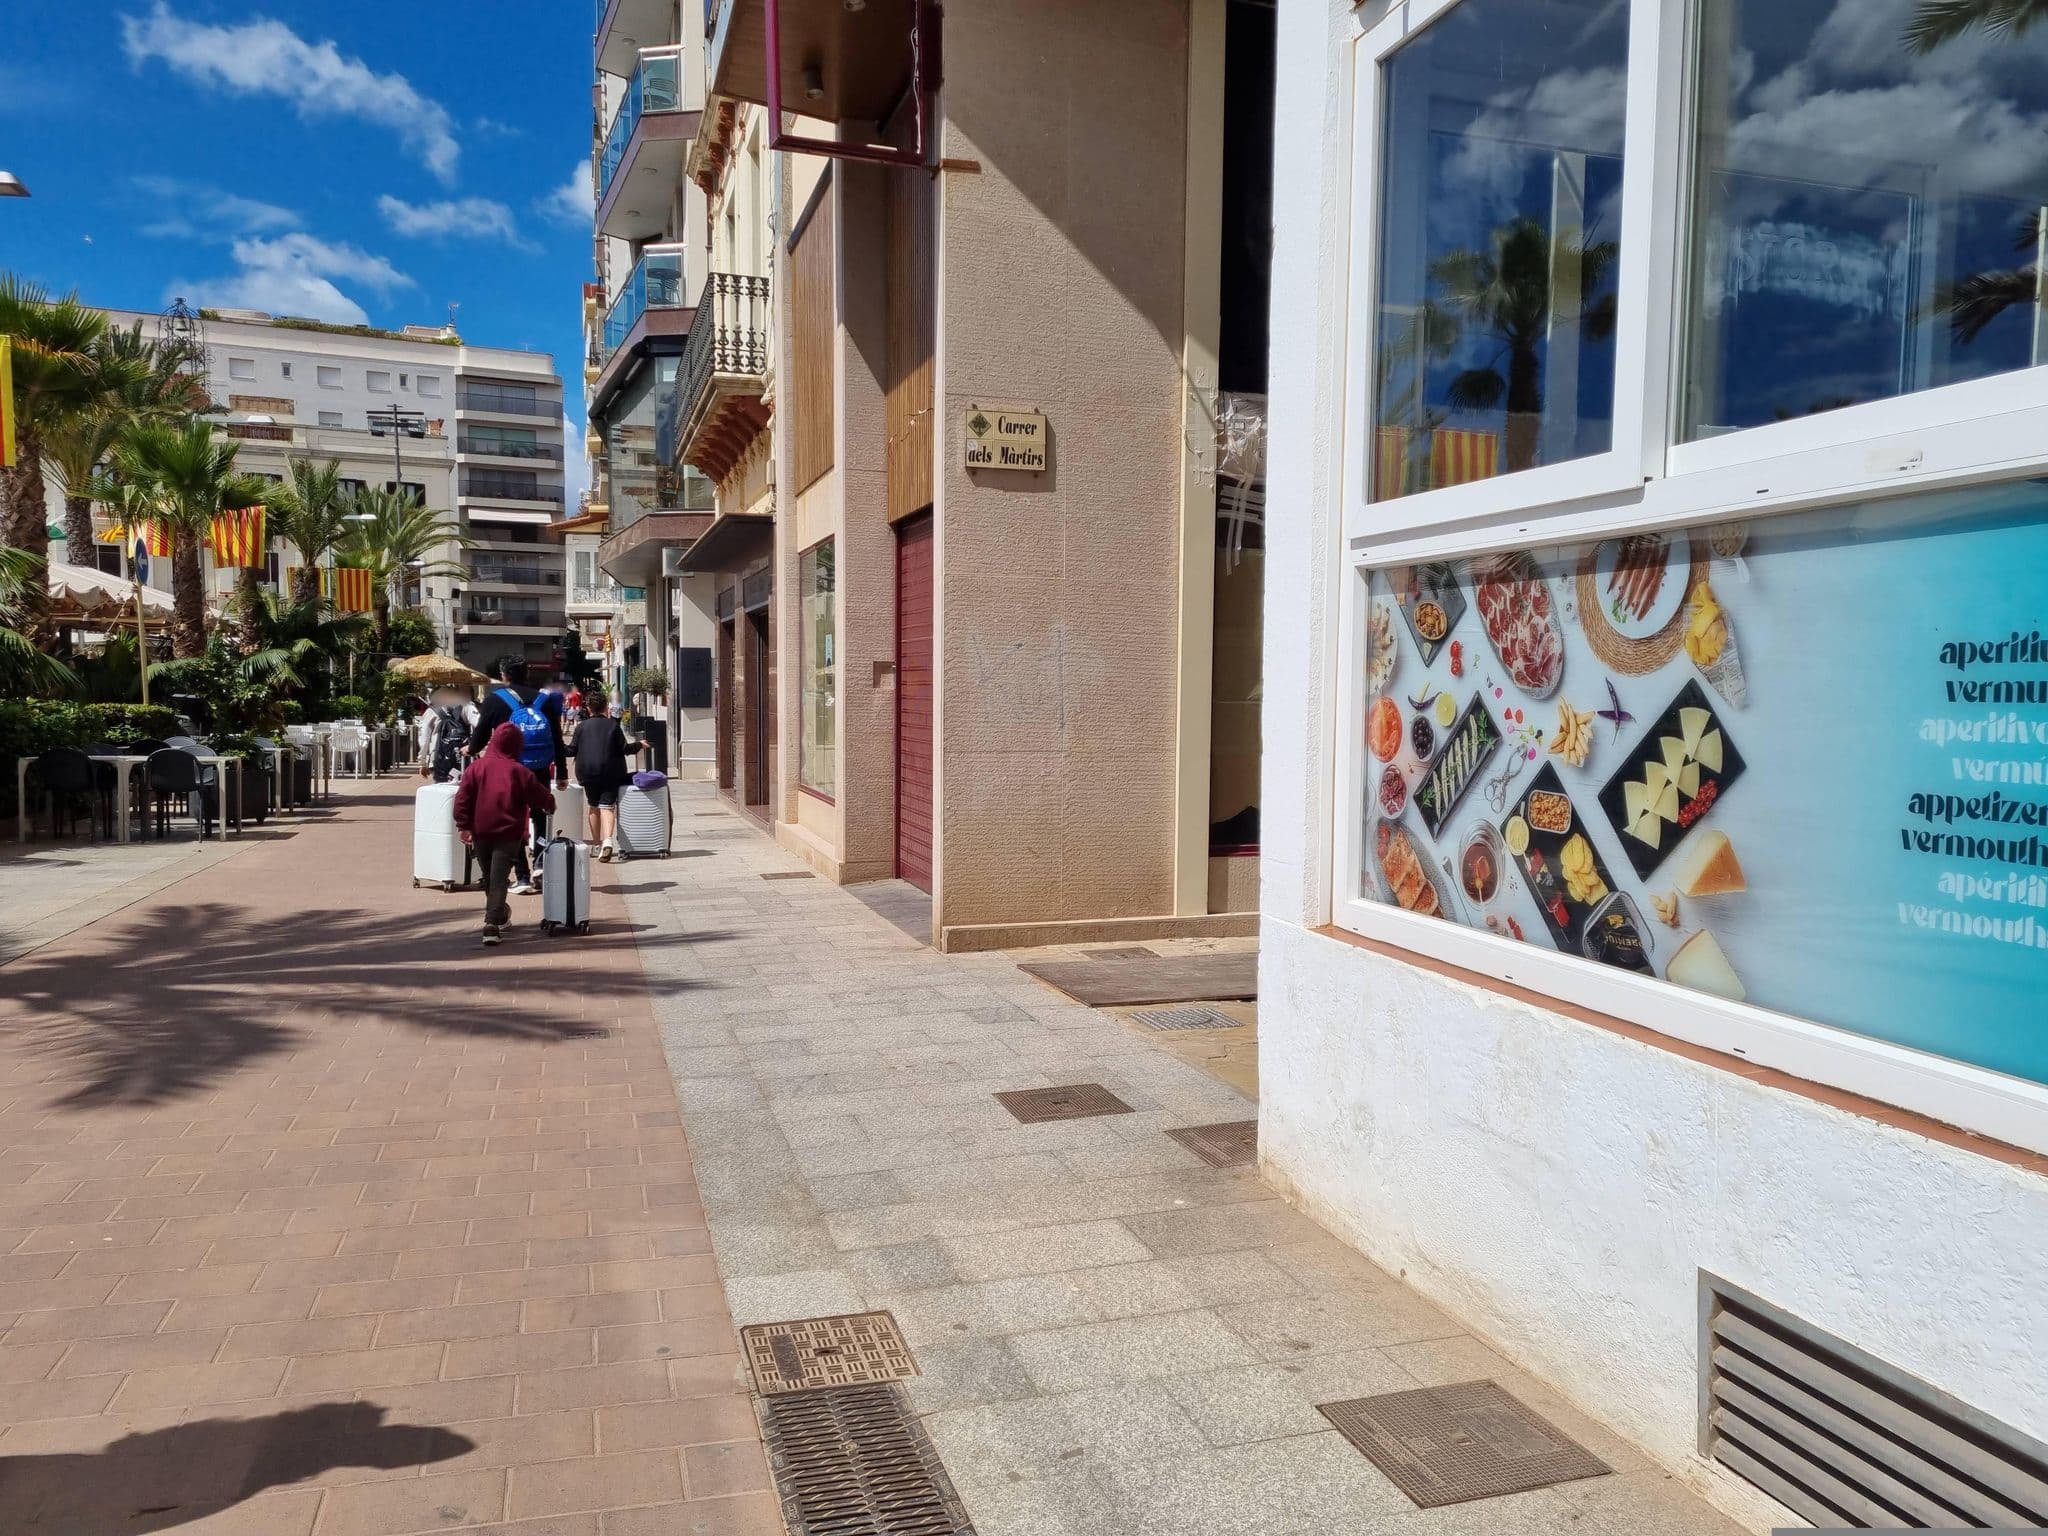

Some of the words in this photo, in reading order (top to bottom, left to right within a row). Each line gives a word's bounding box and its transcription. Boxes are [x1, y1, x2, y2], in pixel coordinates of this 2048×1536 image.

[998, 415, 1037, 435] Carrer
[1000, 447, 1043, 466] Màrtirs
[1919, 711, 2048, 748] aperitivo
[1908, 790, 2048, 827] appetizer
[1901, 828, 2048, 868] vermouth
[1897, 901, 2048, 949] vermouth
